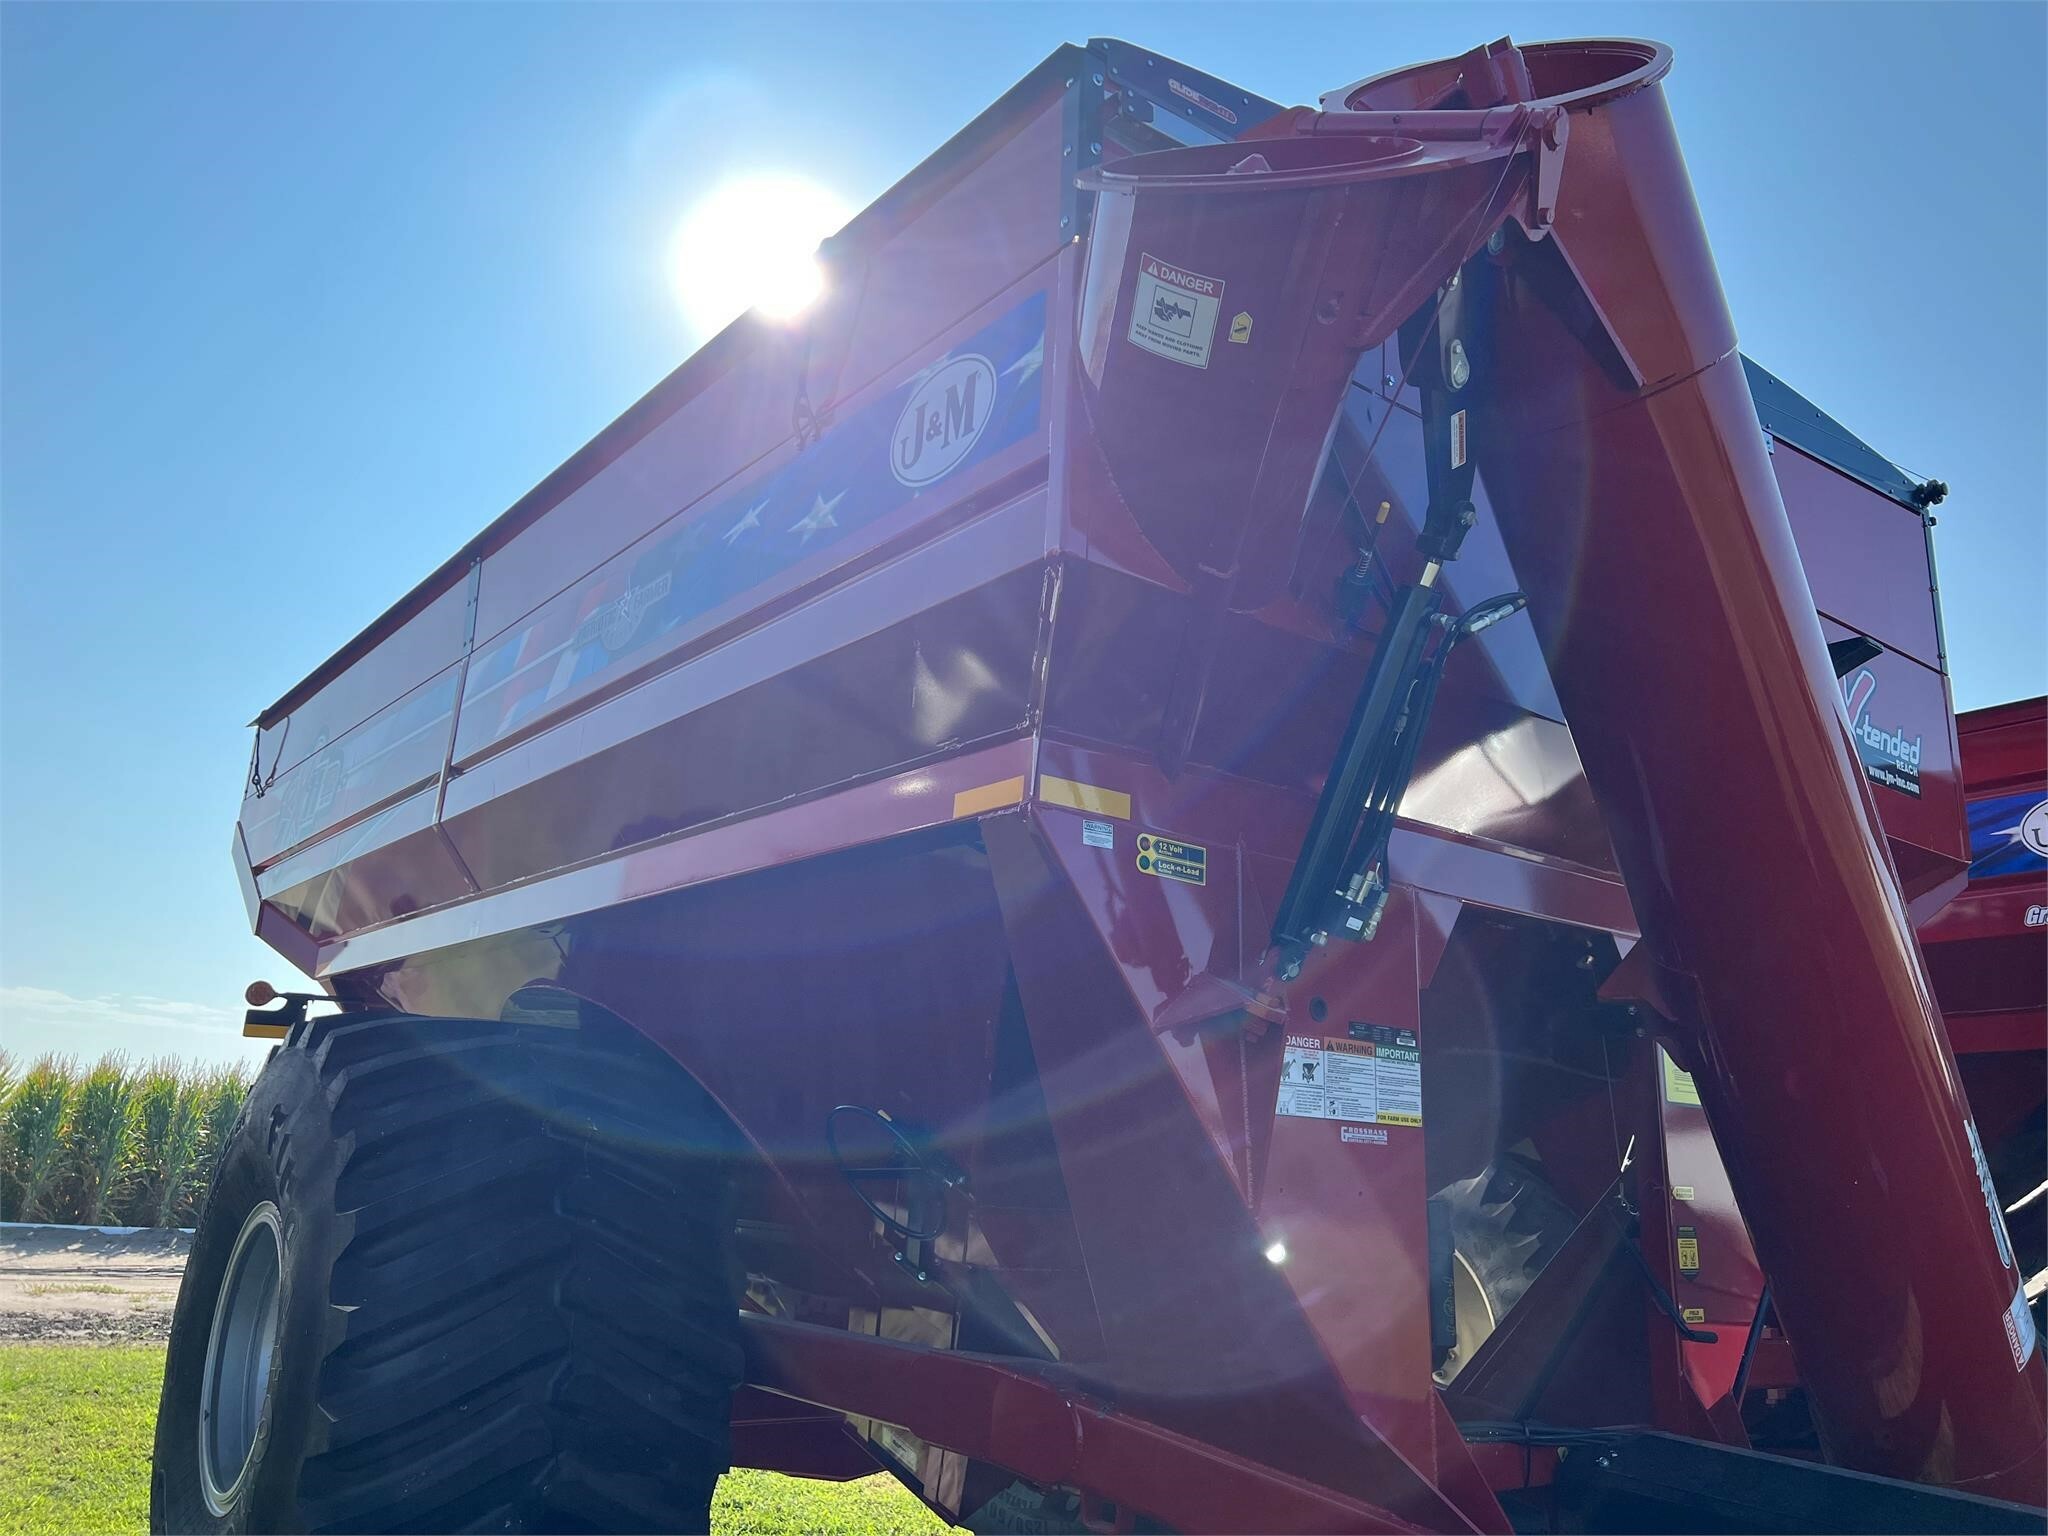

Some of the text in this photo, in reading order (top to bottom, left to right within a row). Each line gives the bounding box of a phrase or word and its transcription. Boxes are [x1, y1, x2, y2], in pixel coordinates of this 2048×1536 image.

[1160, 267, 1214, 294] DANGER
[900, 370, 980, 470] J&M
[1158, 842, 1183, 854] 12 Volt
[1158, 860, 1200, 876] Lock-n-Load
[1335, 1041, 1373, 1056] WARNING
[1376, 1047, 1420, 1062] IMPORTANT
[2004, 1311, 2022, 1357] DANGER
